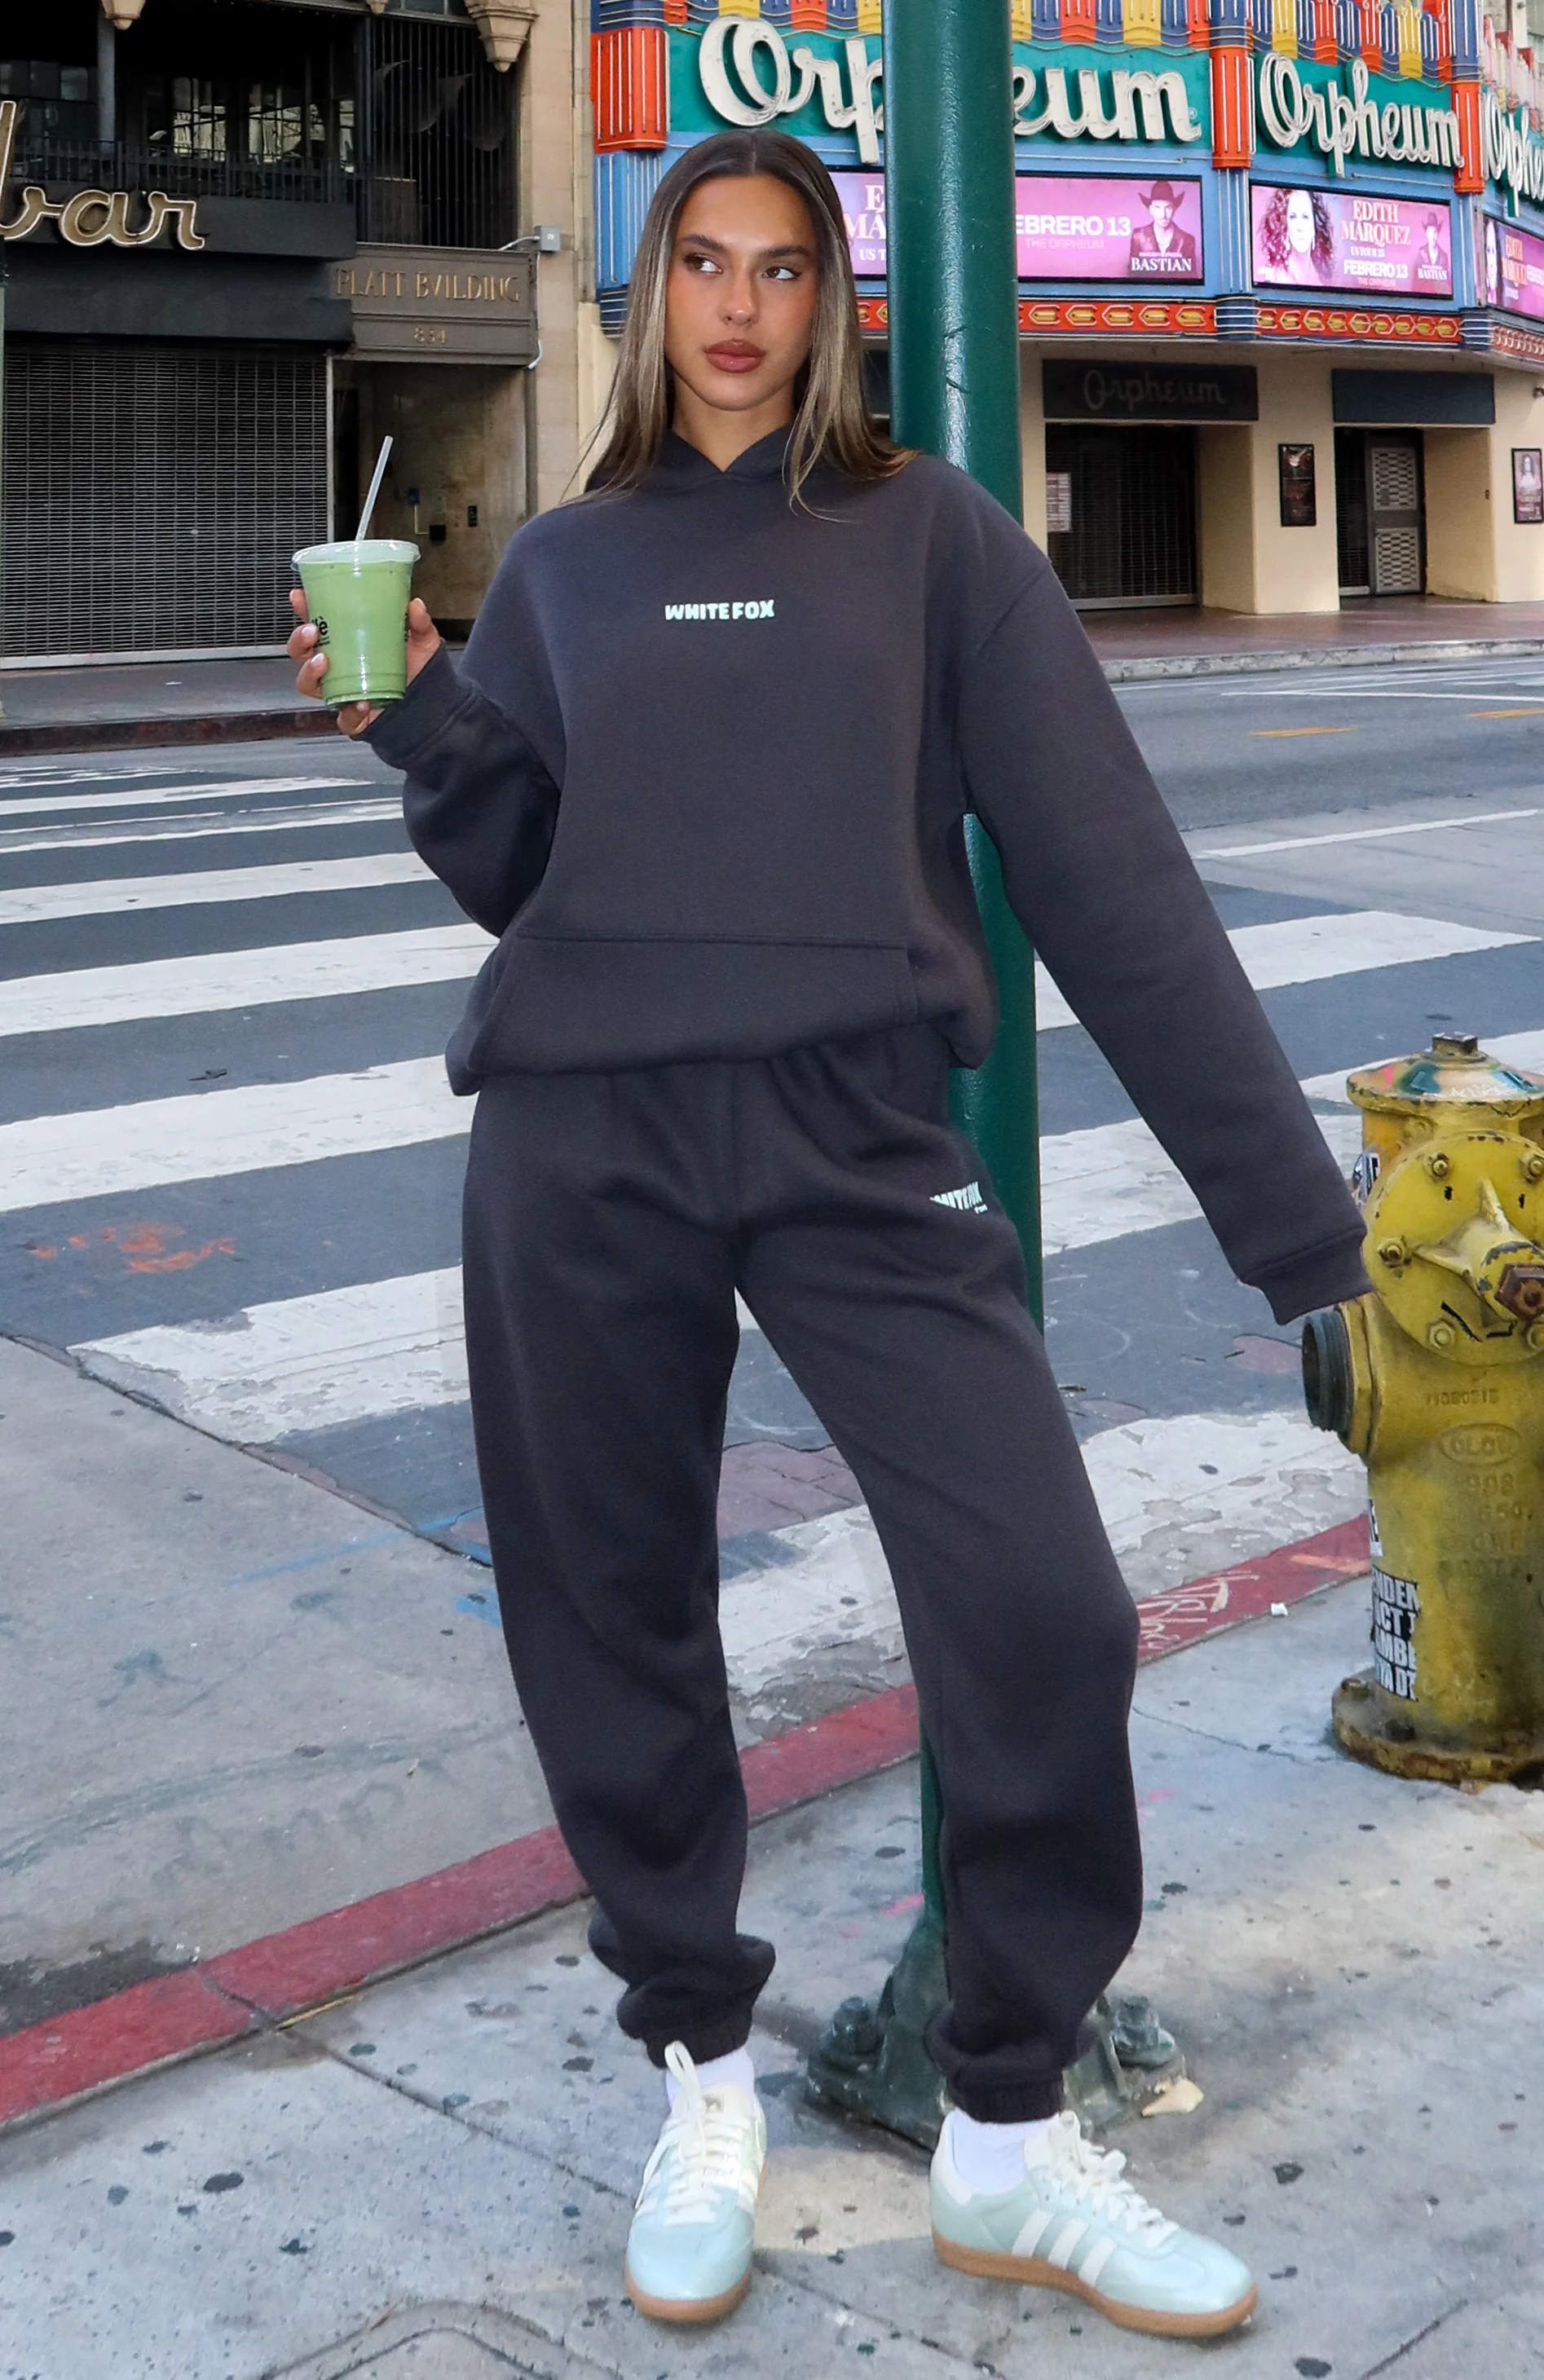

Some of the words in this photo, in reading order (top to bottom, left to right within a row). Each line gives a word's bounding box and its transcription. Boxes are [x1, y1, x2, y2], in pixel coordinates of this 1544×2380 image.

[699, 15, 1202, 165] Orpeum
[1259, 52, 1465, 178] Orpheum
[1486, 90, 1544, 218] Orphe
[1353, 200, 1399, 223] EDITH
[1015, 214, 1104, 236] EBRERO
[1107, 217, 1132, 236] 13
[859, 248, 876, 261] US
[1025, 237, 1048, 249] THE
[1048, 238, 1105, 250] ORPHEUM
[1131, 257, 1192, 271] BASTIAN
[1343, 259, 1396, 278] FEBRERO
[1396, 263, 1409, 279] 13
[1418, 267, 1448, 280] BASTIAN
[336, 267, 406, 298] PLATT
[1083, 369, 1227, 411] Orpheum
